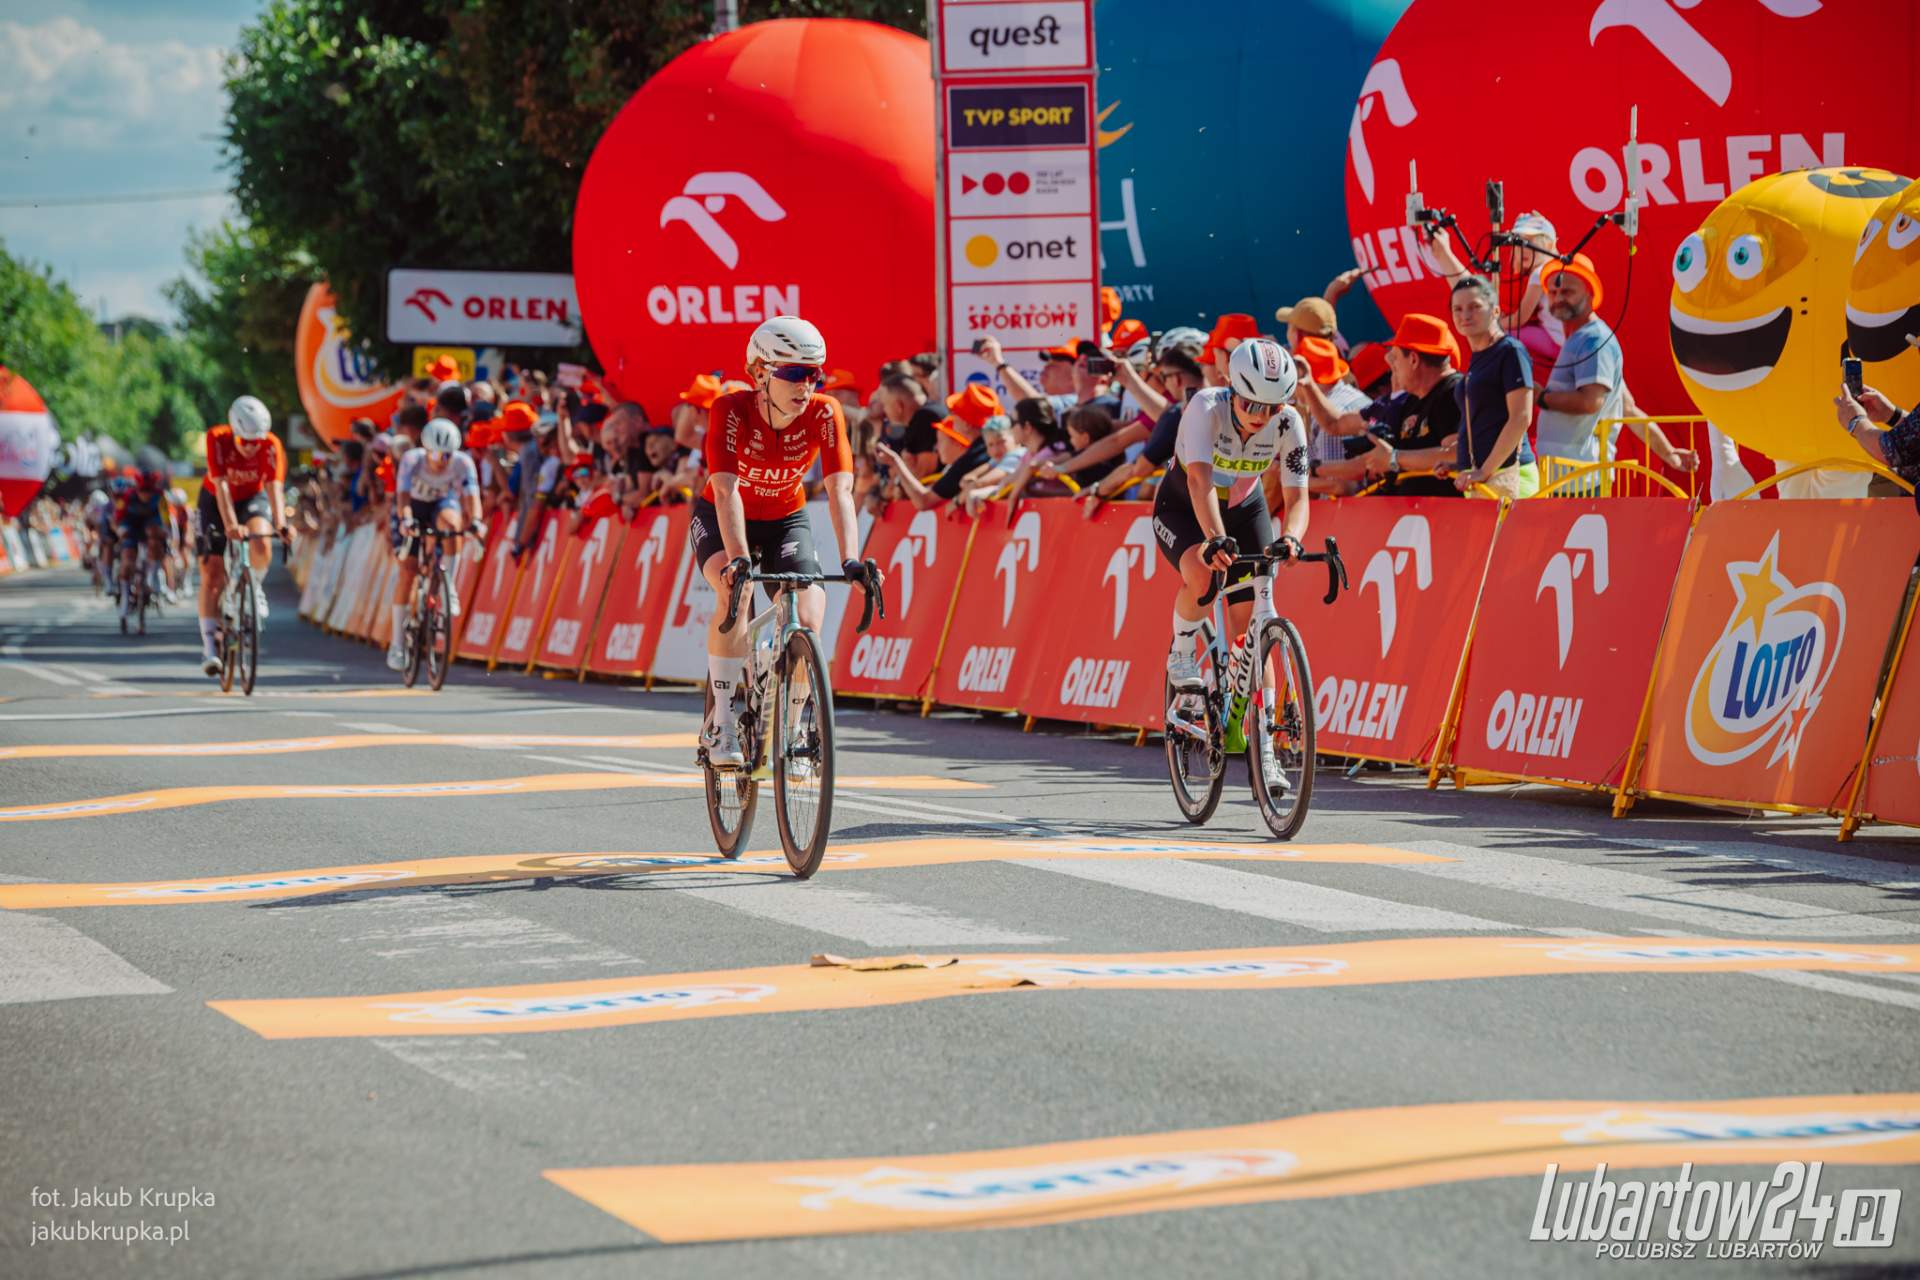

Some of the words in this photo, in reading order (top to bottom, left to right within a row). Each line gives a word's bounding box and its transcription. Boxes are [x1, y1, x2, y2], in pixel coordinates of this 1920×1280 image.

[970, 15, 1061, 56] quest
[963, 109, 1005, 126] TVP
[1008, 107, 1073, 126] SPORT
[1569, 132, 1845, 213] ORLEN
[1006, 235, 1077, 260] onet
[1353, 225, 1441, 289] RLEN
[463, 296, 568, 321] ORLEN
[647, 284, 799, 326] ORLEN
[968, 311, 1078, 330] SPORTOWY
[725, 410, 742, 454] FENIX
[738, 460, 807, 480] FENIX
[850, 634, 912, 680] ORLEN
[958, 645, 1016, 693] ORLEN
[1723, 626, 1817, 720] LOTTO
[1060, 656, 1130, 708] ORLEN
[1315, 675, 1408, 741] ORLEN
[1486, 689, 1584, 758] ORLEN
